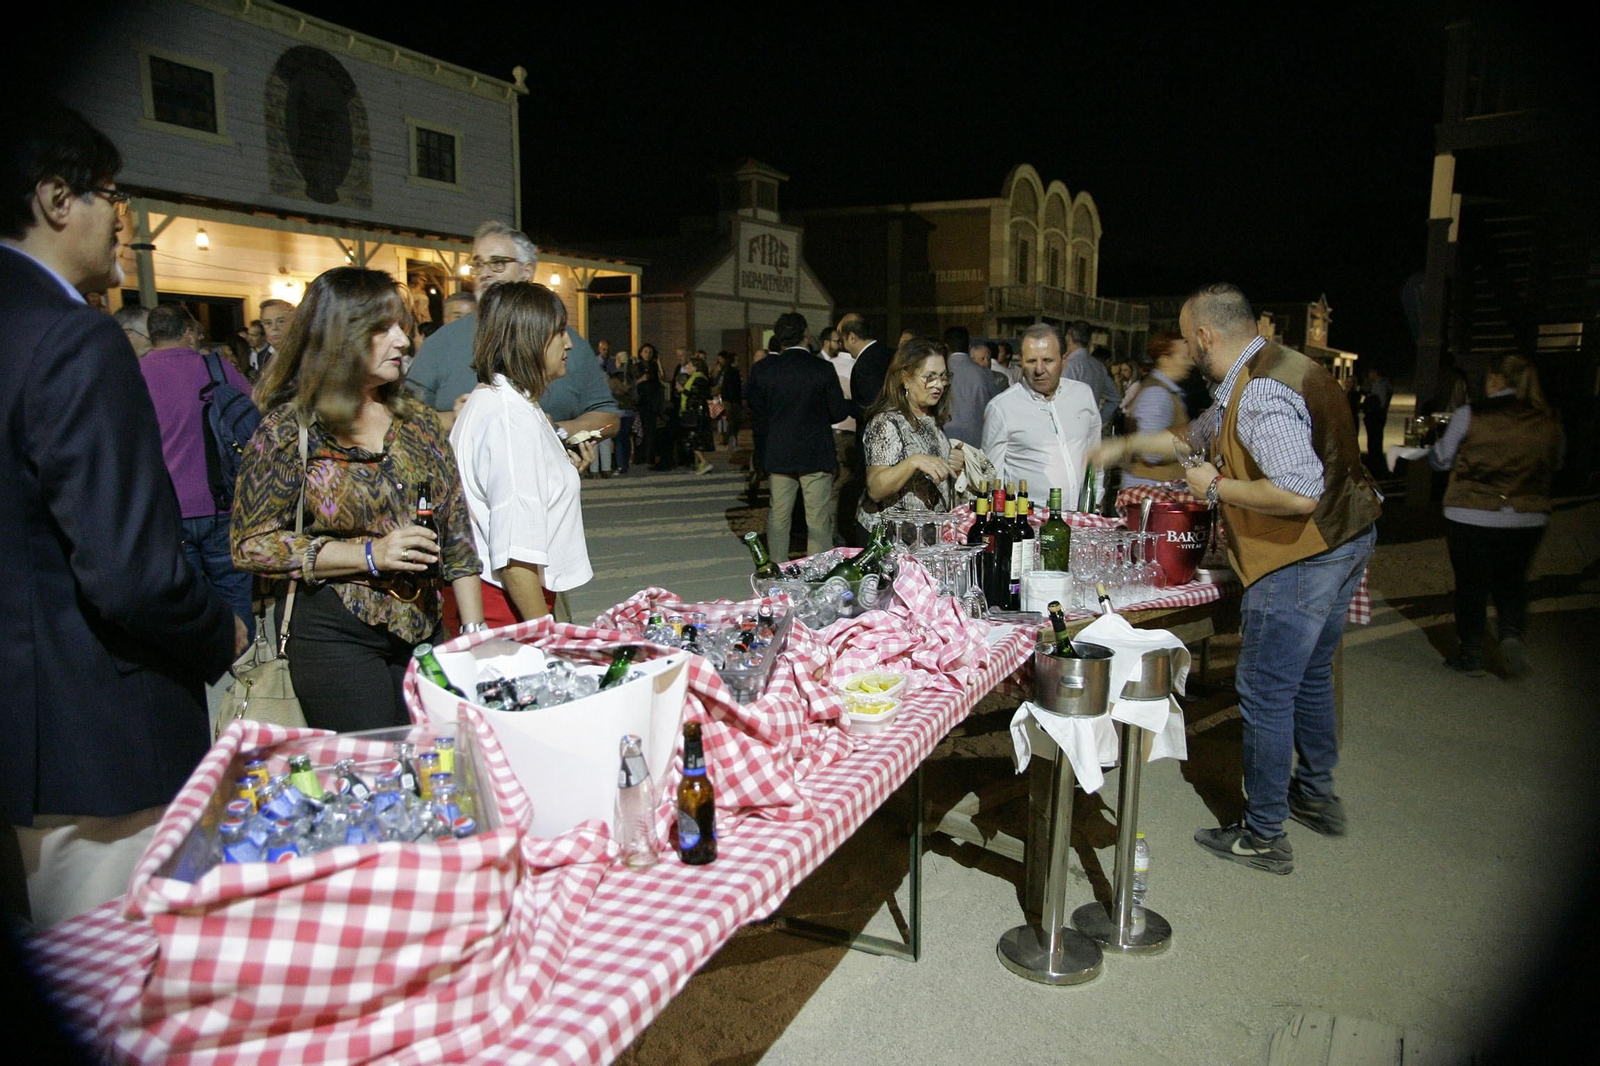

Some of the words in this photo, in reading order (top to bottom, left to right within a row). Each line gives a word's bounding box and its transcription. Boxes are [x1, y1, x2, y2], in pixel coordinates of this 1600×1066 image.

[748, 233, 790, 272] FIRE
[741, 269, 794, 294] DEPARTMENT
[935, 268, 985, 283] TRIBUNAL
